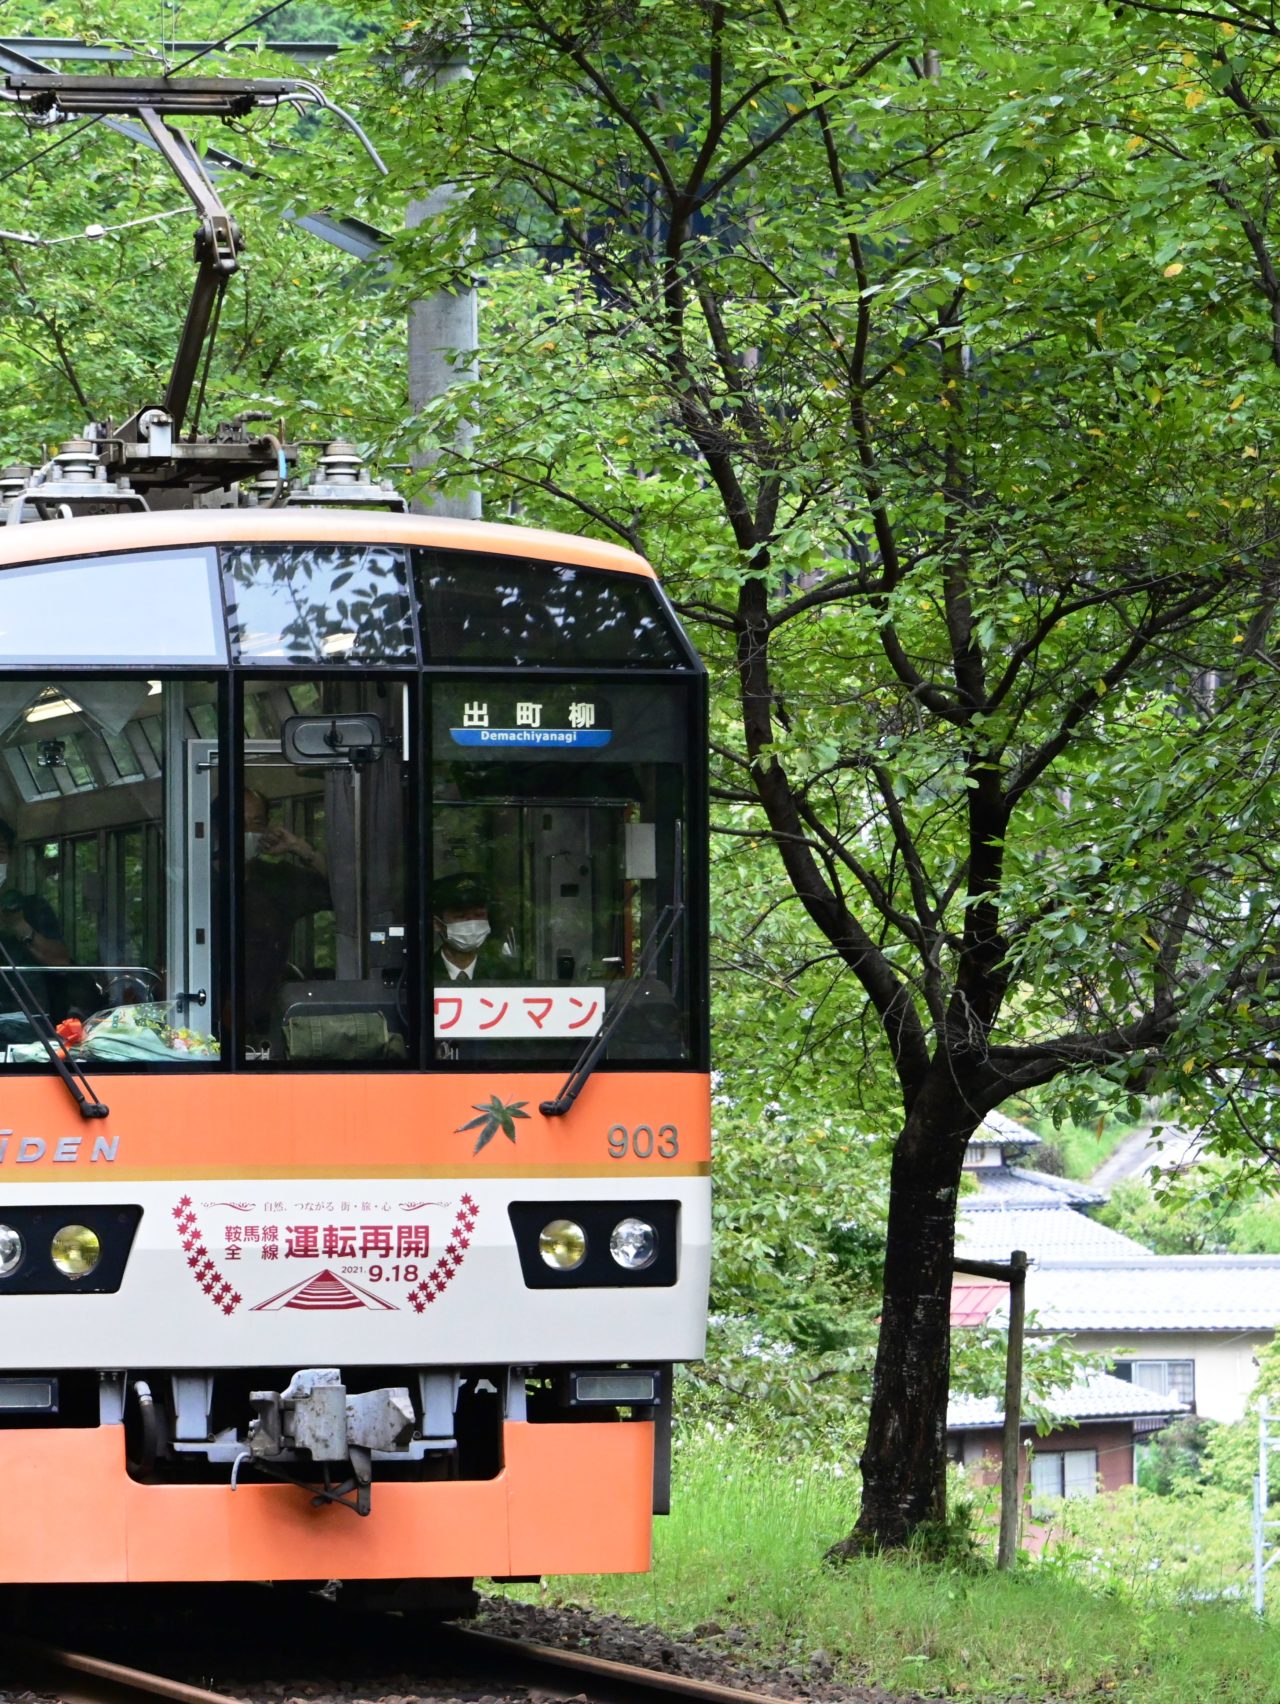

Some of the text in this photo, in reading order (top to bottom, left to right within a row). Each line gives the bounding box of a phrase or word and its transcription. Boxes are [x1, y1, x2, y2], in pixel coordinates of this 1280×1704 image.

[463, 701, 595, 728] 出町柳
[481, 731, 577, 742] Demachiyanagi
[434, 998, 598, 1030] ワンマン
[607, 1124, 679, 1158] 903
[224, 1225, 279, 1242] 鞍馬線
[284, 1225, 430, 1259] 運転再開
